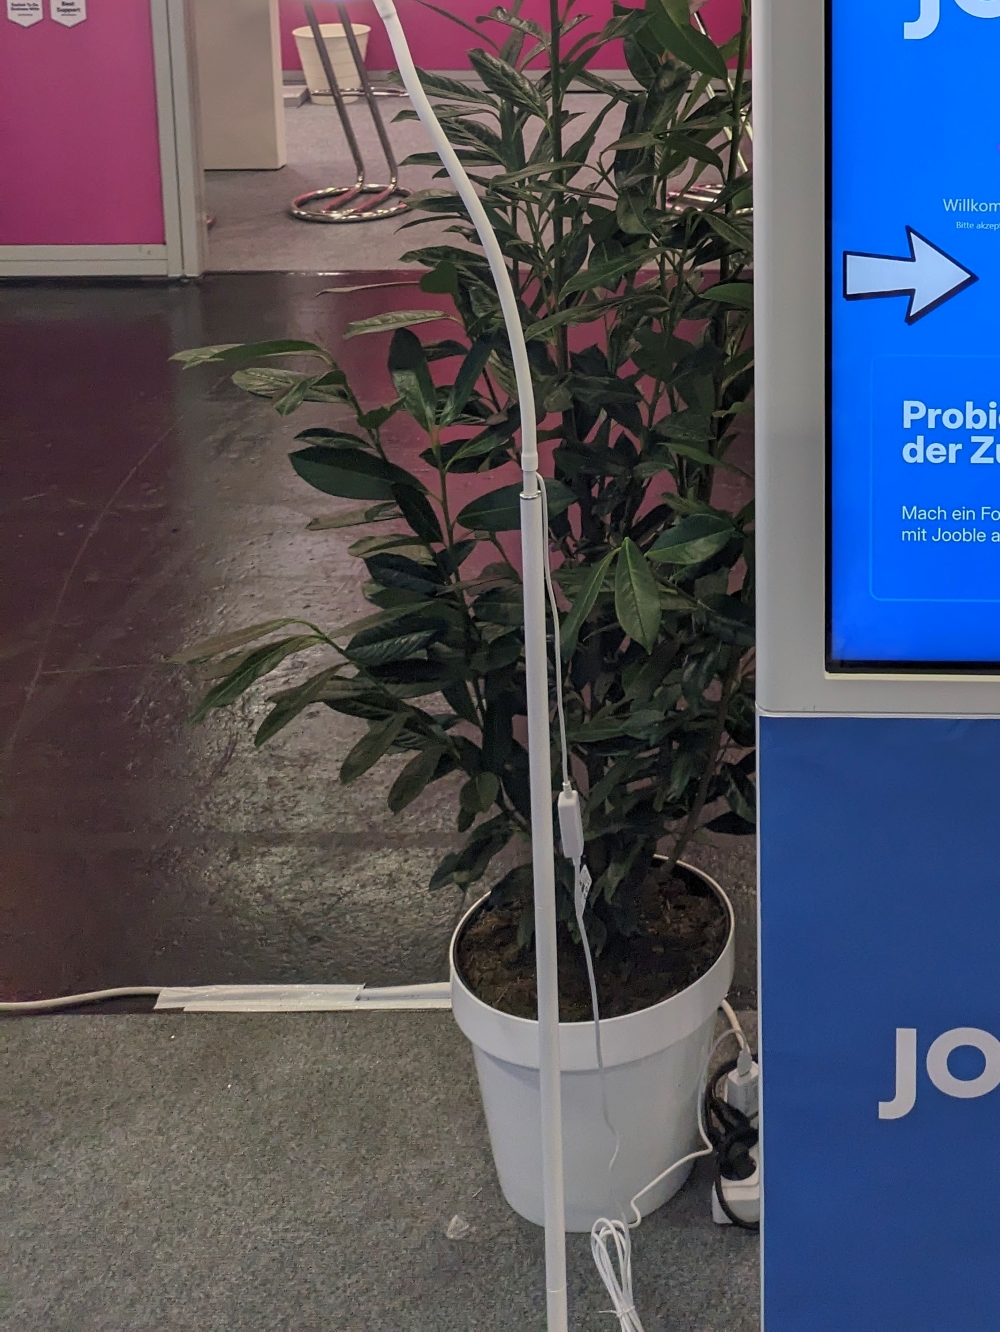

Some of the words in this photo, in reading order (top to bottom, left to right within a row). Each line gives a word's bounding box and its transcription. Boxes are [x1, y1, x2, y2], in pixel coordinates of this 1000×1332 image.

[956, 221, 975, 229] Bitte
[902, 435, 963, 464] der
[902, 505, 947, 520] Mach
[951, 506, 976, 521] ein
[901, 527, 927, 542] mit
[931, 527, 987, 542] Jooble
